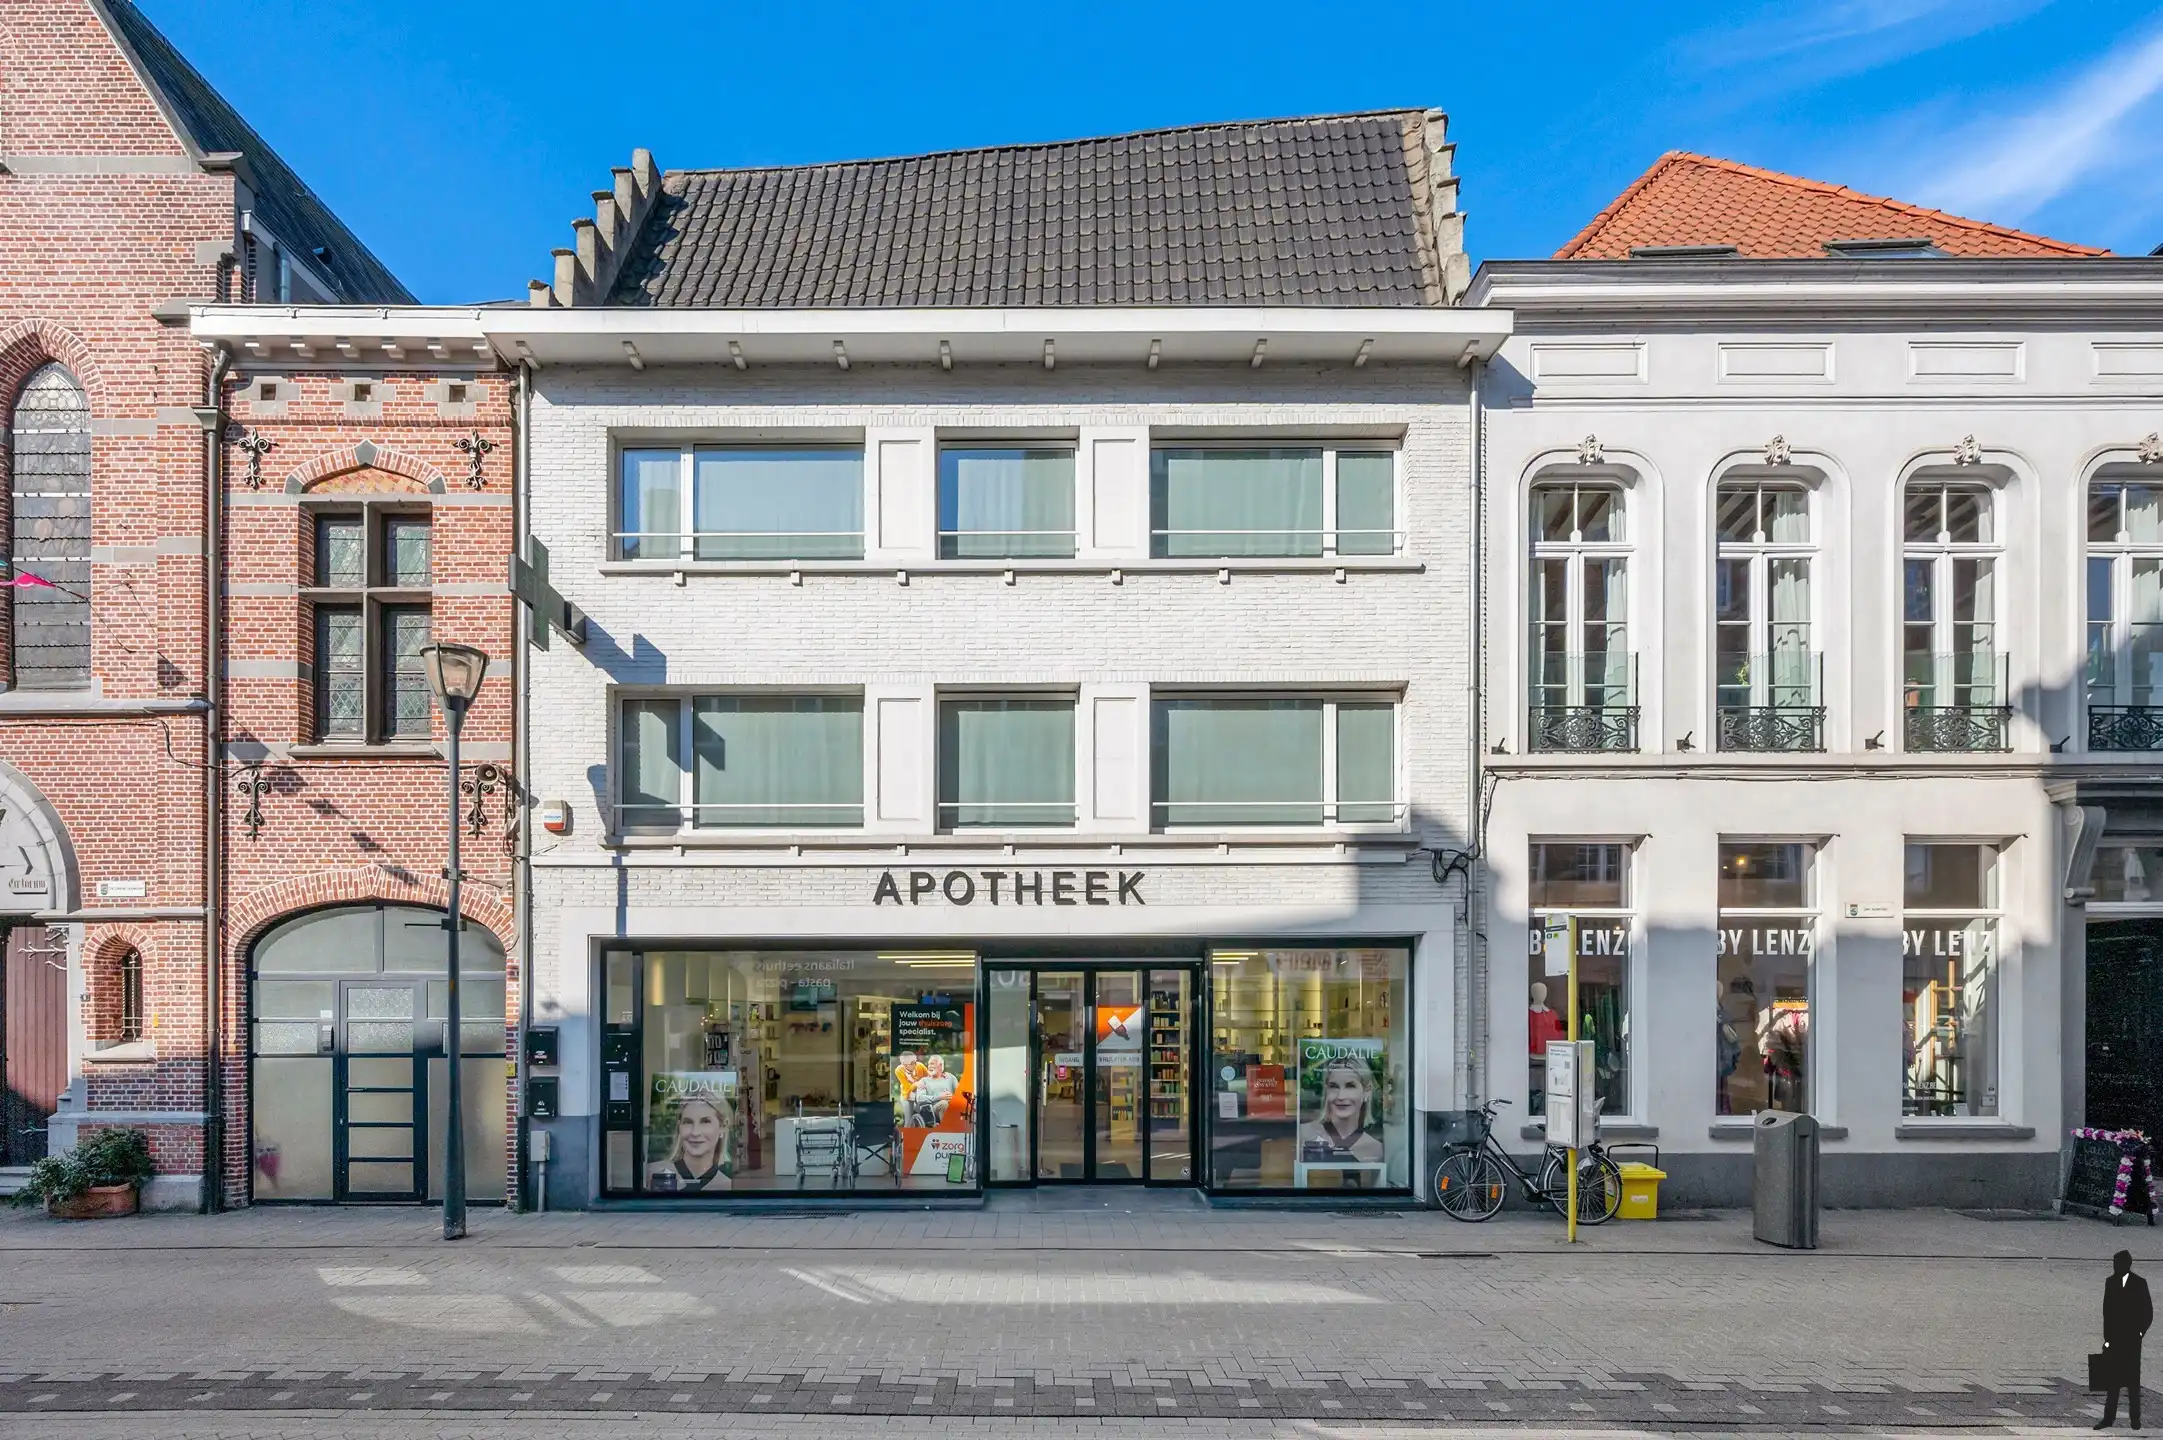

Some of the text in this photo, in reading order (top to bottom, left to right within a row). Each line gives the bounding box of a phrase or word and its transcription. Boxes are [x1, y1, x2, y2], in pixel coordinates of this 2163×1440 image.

[872, 871, 1146, 906] APOTHEEK
[1529, 929, 1625, 955] B ENZ
[1753, 929, 1809, 955] LENZ
[931, 1011, 941, 1019] bij
[899, 1019, 917, 1027] jouw
[899, 1028, 936, 1036] specialist.
[1305, 1046, 1379, 1059] CAUDALIE
[655, 1079, 732, 1093] CAUDALIE
[941, 1143, 965, 1152] zorg
